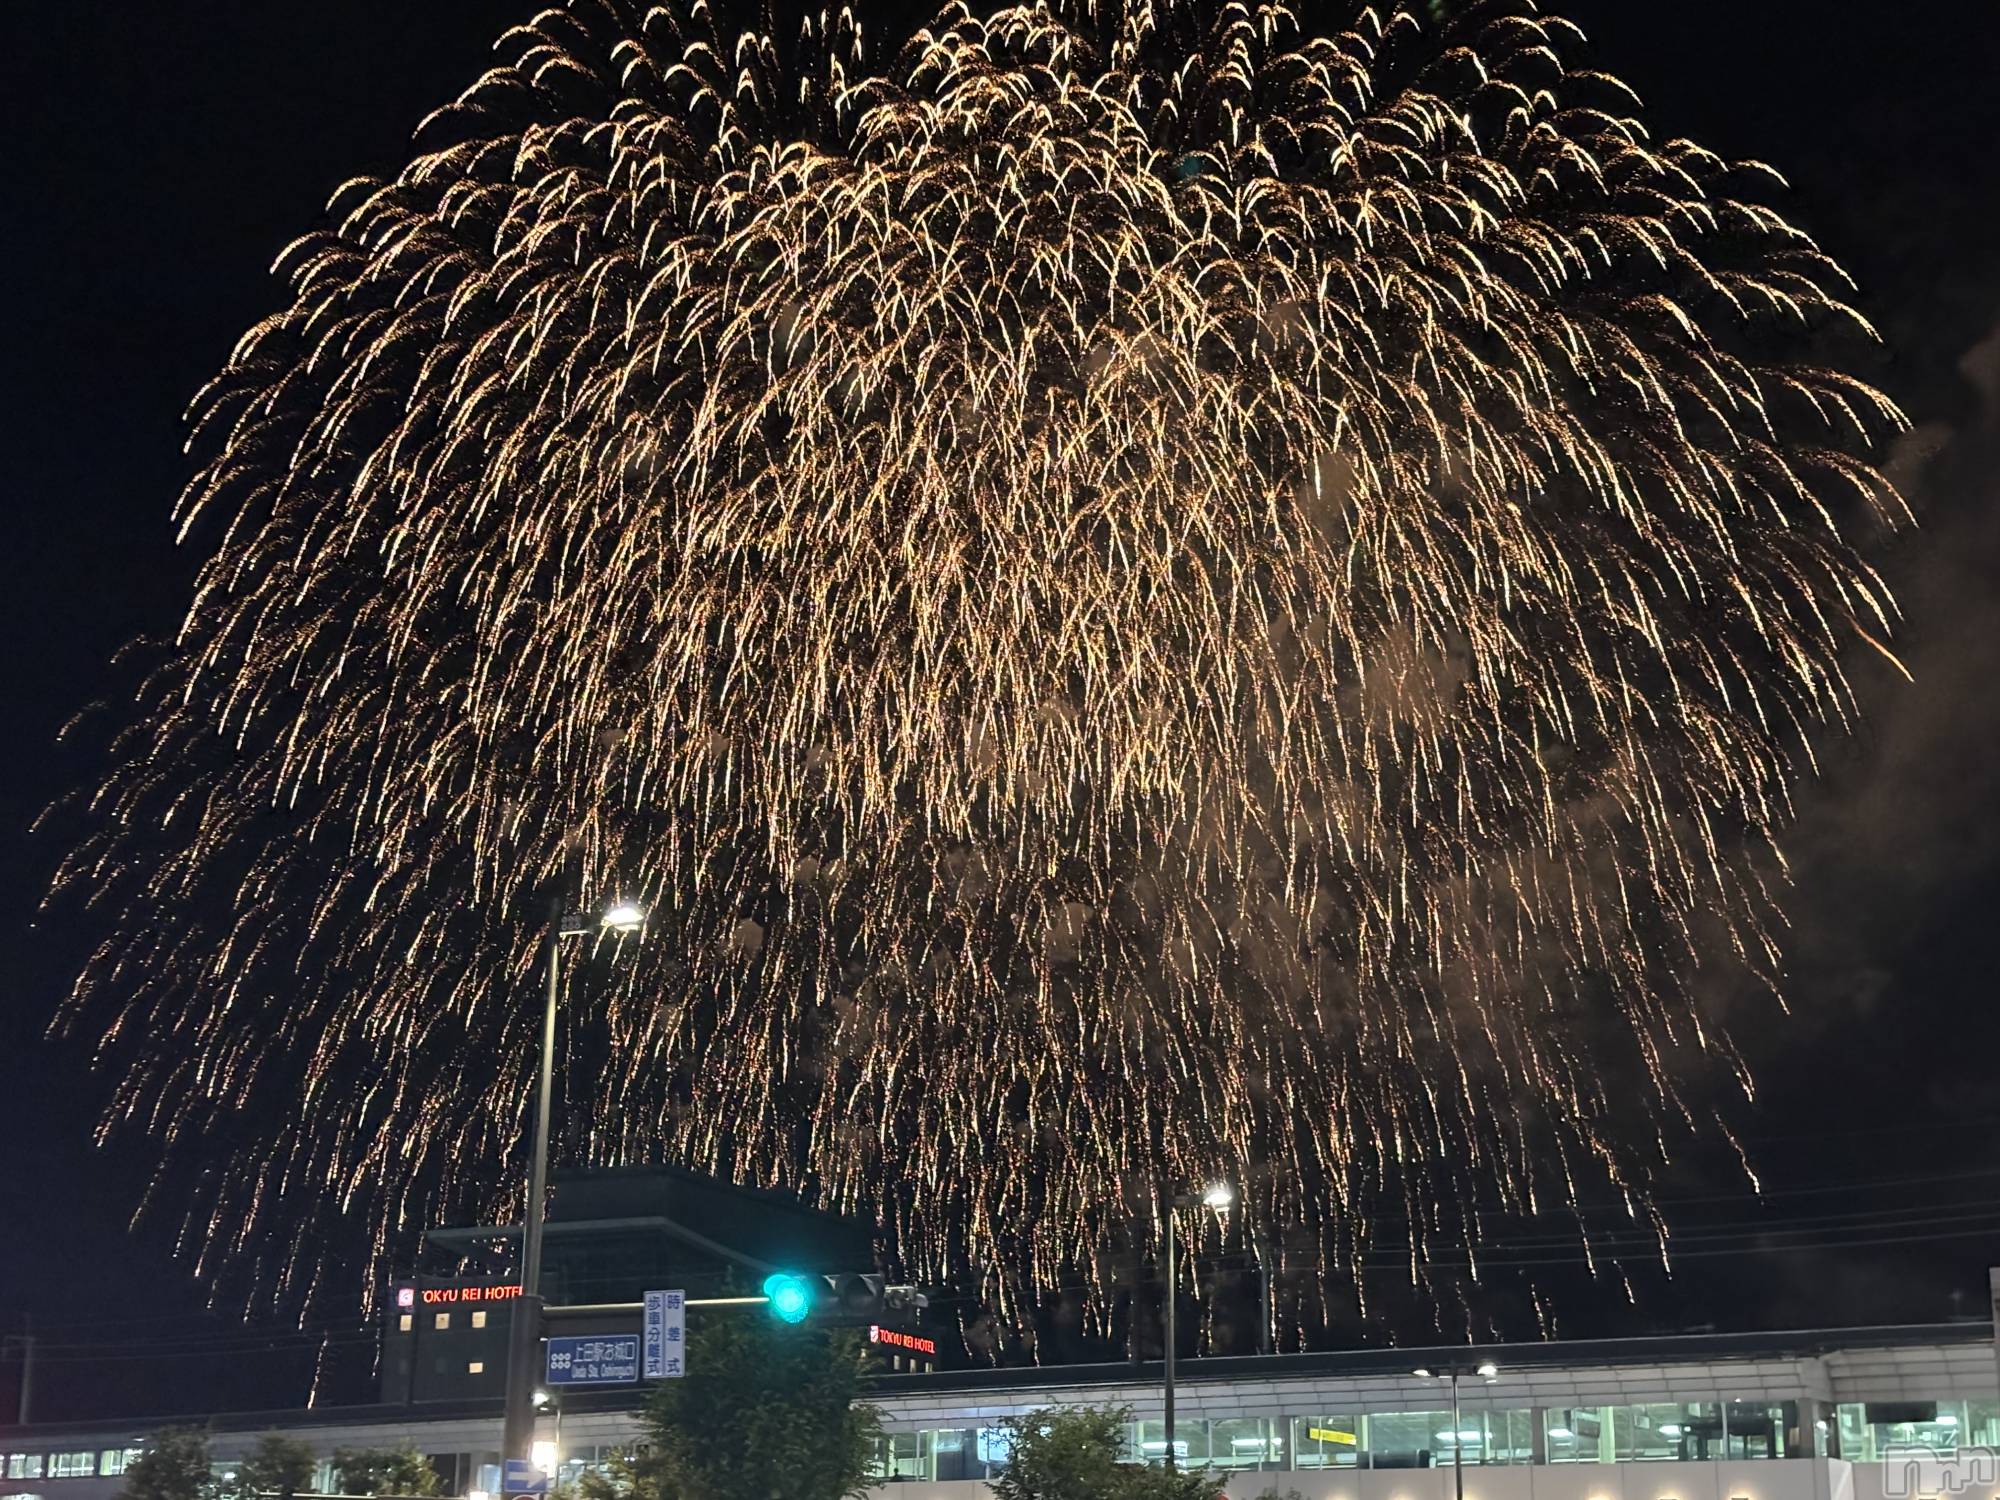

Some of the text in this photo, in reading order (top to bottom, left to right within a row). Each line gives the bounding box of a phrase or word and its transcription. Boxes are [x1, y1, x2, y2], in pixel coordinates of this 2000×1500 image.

[422, 1289, 459, 1303] OKYU
[461, 1287, 481, 1301] REI
[647, 1295, 661, 1375] 歩車分離式
[666, 1294, 681, 1375] 時差式
[880, 1329, 935, 1354] TOKYU REI HOTEL
[572, 1341, 635, 1362] 上田駅お城口
